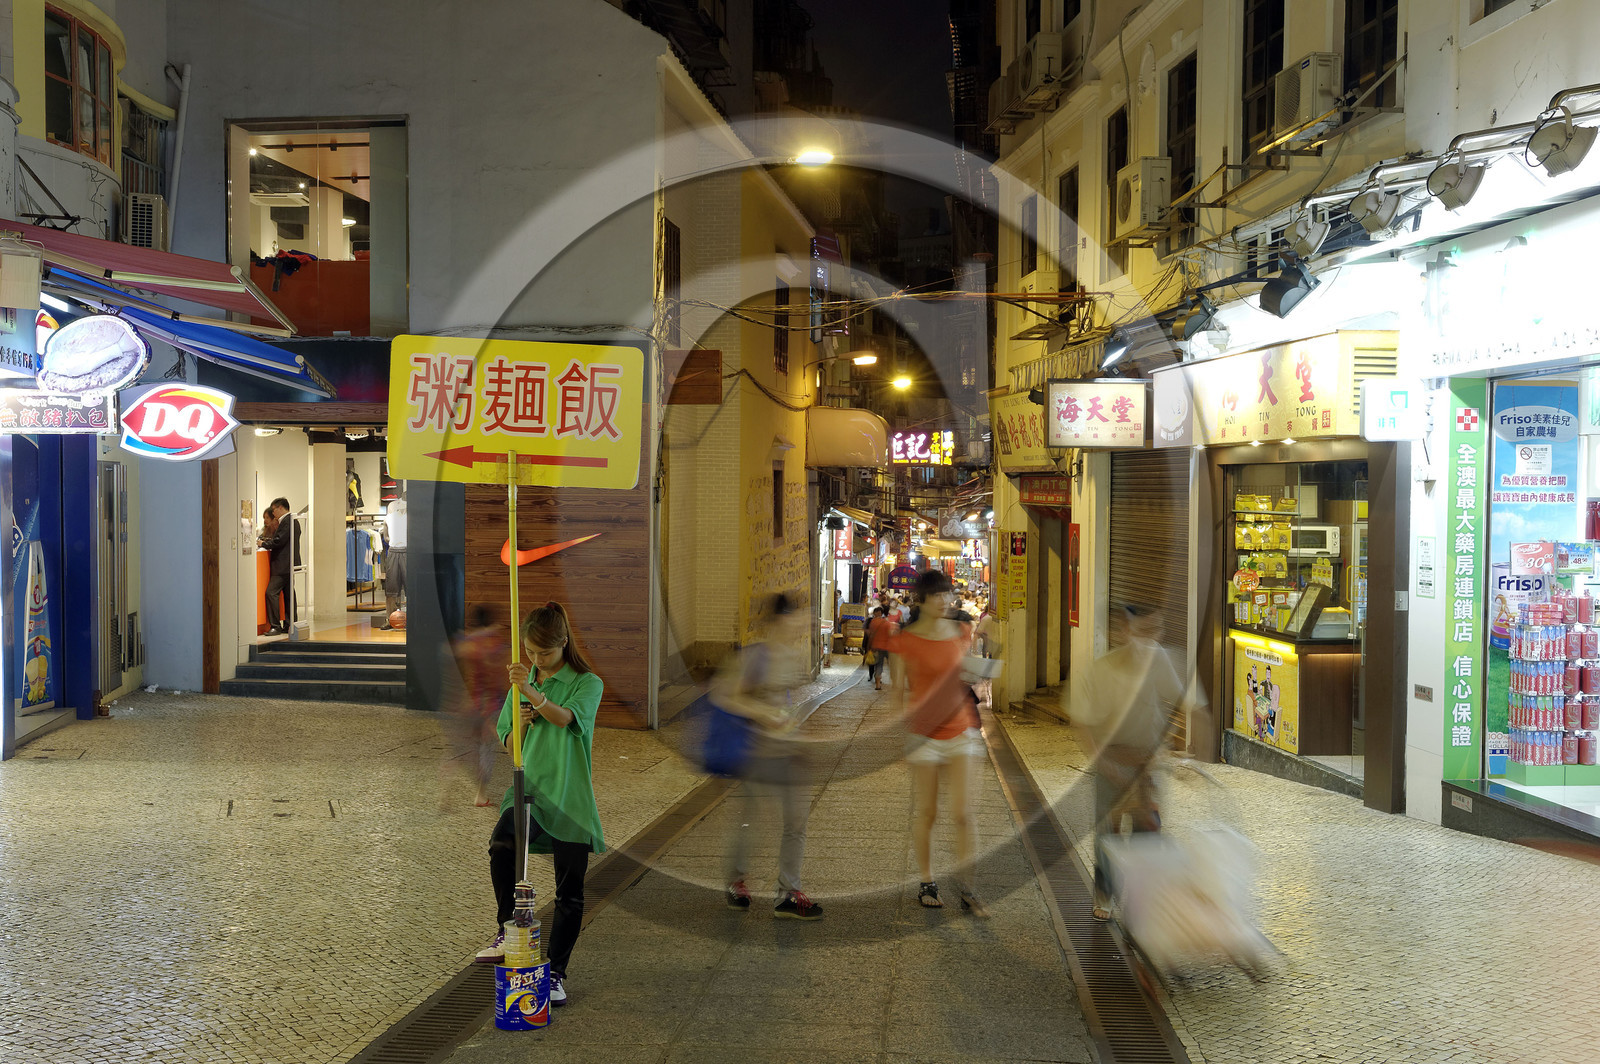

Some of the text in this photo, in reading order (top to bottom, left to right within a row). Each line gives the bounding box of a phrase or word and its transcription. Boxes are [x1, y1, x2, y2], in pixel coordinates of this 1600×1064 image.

[1056, 396, 1135, 423] 海天堂
[1259, 412, 1270, 422] TIN
[1296, 406, 1316, 417] TONG
[1500, 414, 1570, 426] Friso 美素佳兒
[1516, 426, 1556, 438] 自家農場
[1502, 476, 1566, 486] 為優質營養把關
[1493, 492, 1574, 502] 讓寶寶由內健康成長
[1498, 575, 1542, 591] Friso
[1452, 444, 1477, 748] 全澳最大藥房連鎖店 信心保證
[510, 966, 544, 990] 好立克
